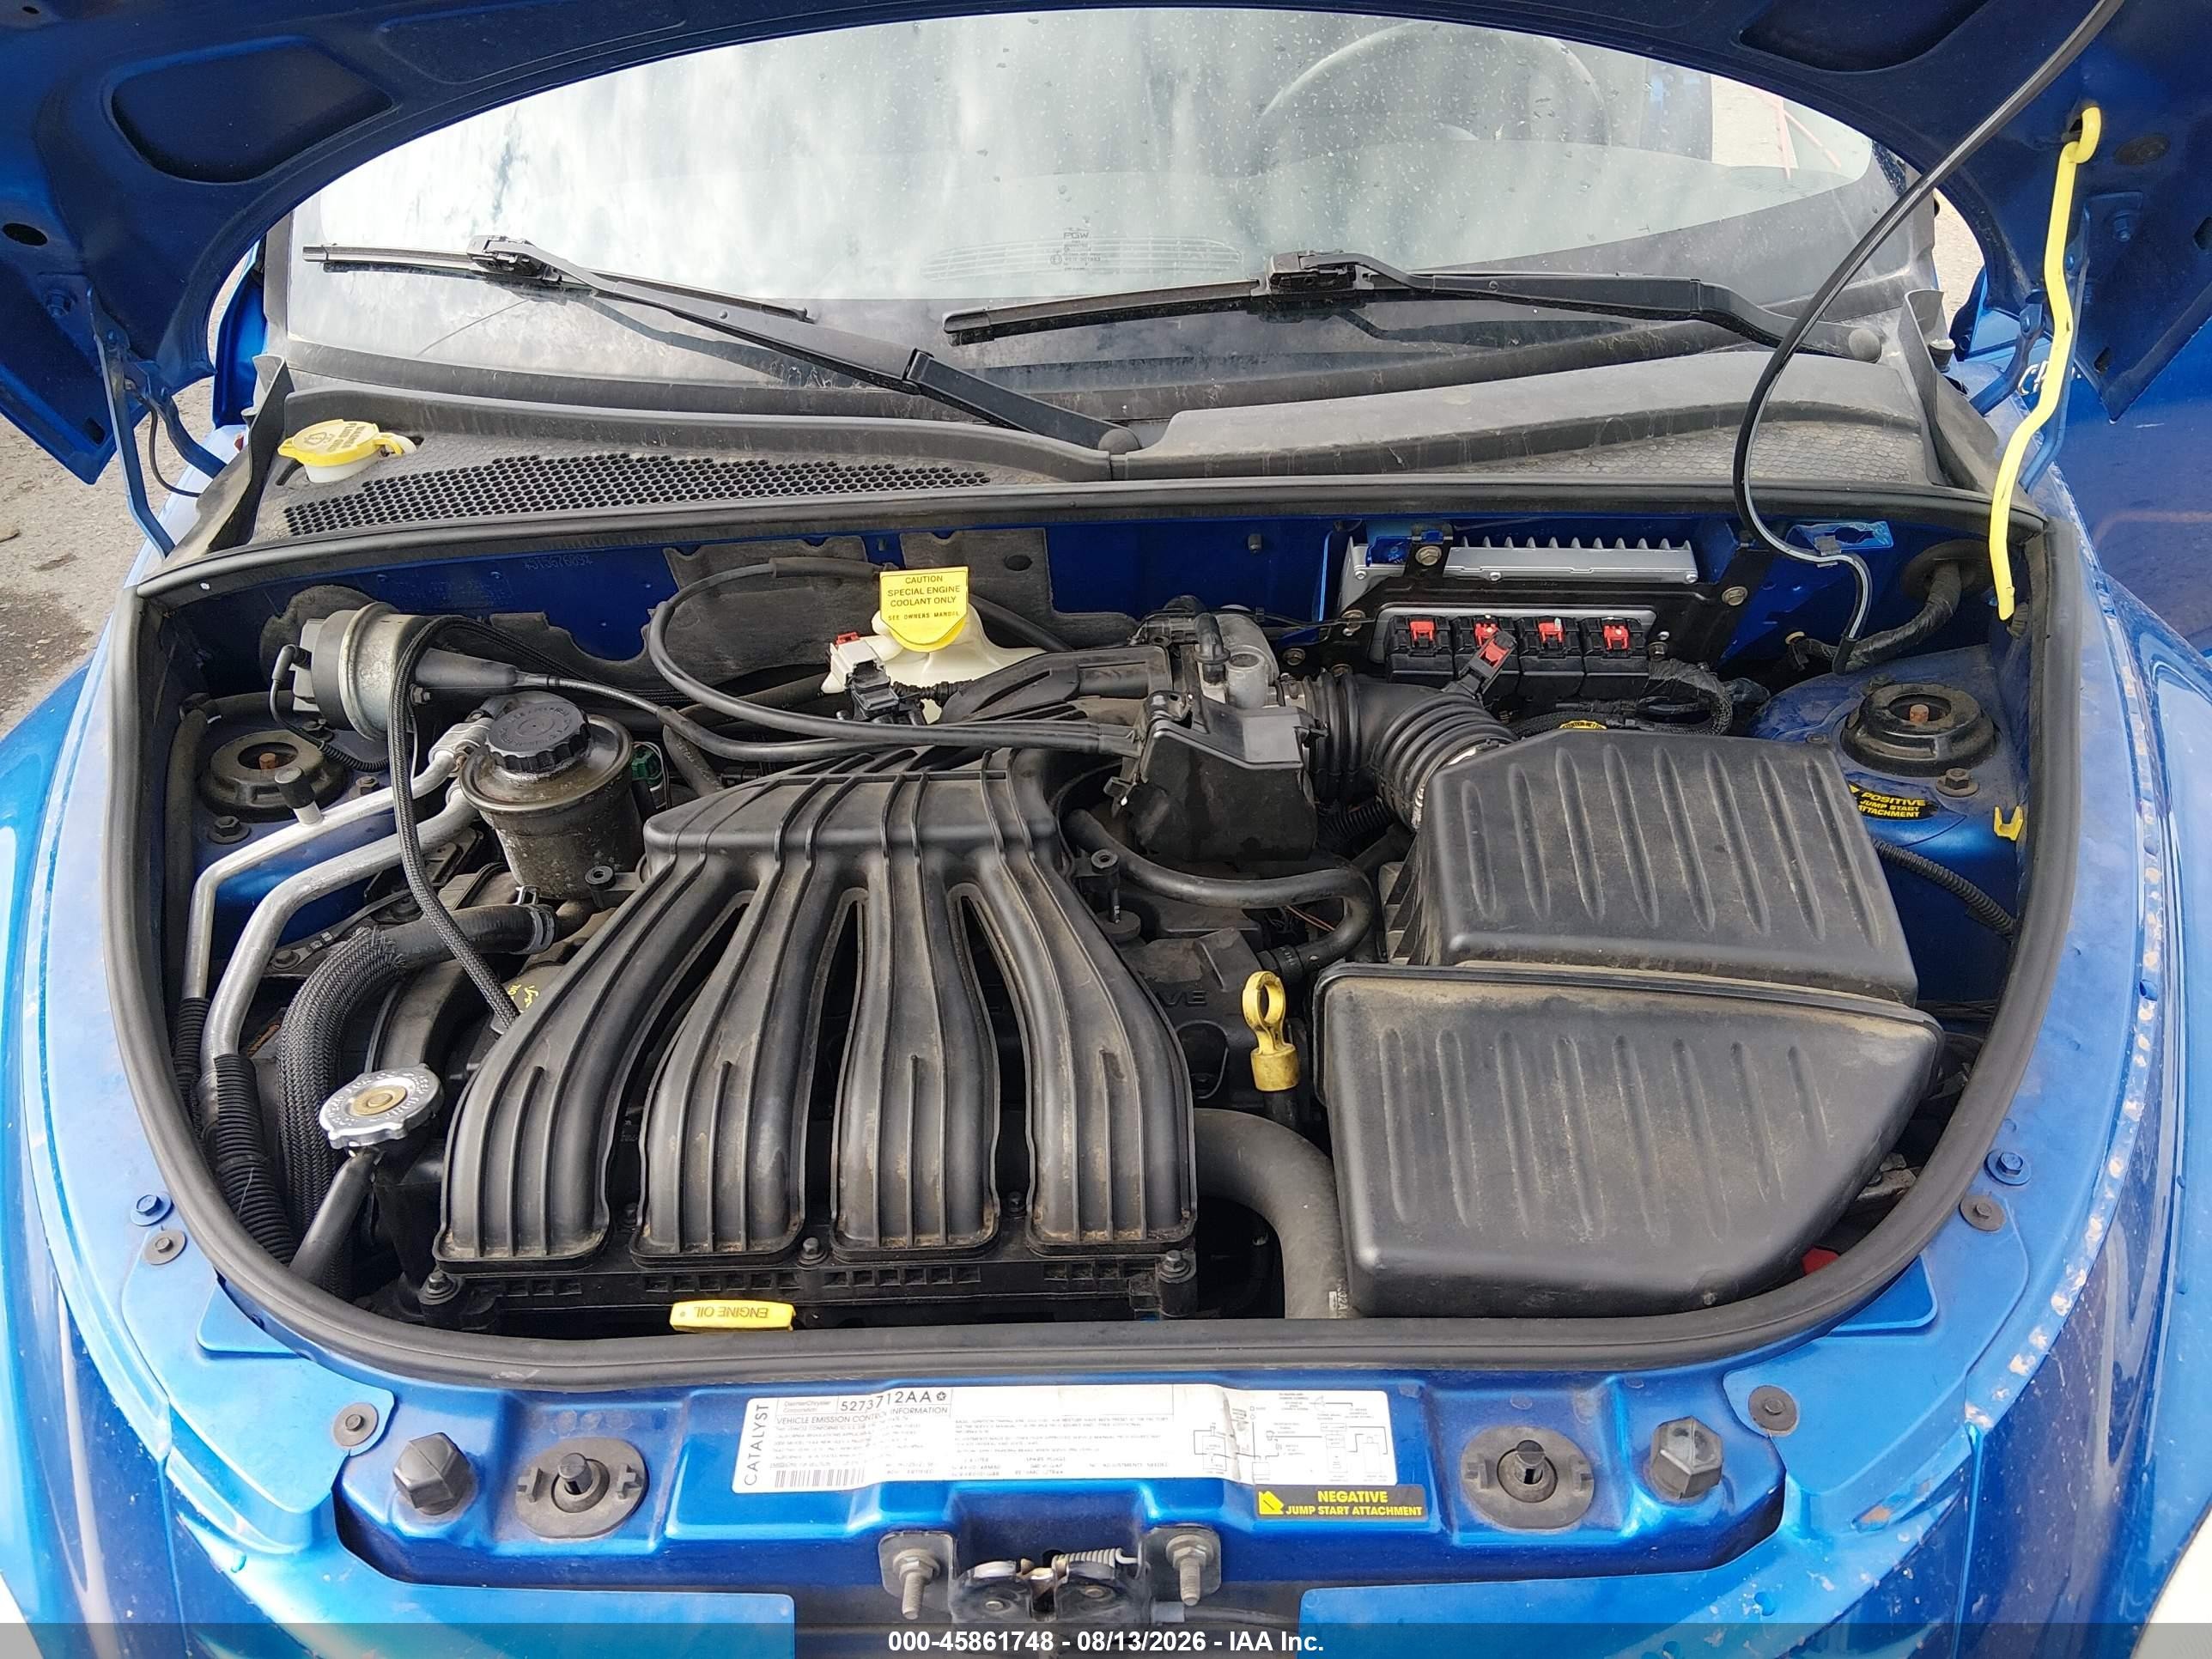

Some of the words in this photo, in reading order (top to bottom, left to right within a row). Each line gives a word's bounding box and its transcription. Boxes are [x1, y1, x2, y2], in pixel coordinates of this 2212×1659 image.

[905, 575, 943, 585] CAUTION
[888, 587, 924, 597] SPECIAL
[927, 586, 961, 594] ENGINE
[890, 598, 932, 607] COOLANT
[933, 596, 957, 605] ONLY
[1860, 799, 1887, 809] JUMP
[1861, 792, 1926, 806] POSITIVE
[1857, 805, 1920, 817] ATTACHMENT
[507, 984, 521, 995] OIL
[694, 1306, 714, 1318] OIL
[717, 1306, 769, 1319] ENGINE
[840, 1390, 932, 1412] 5273712AA
[811, 1415, 850, 1424] EMISSION
[744, 1404, 769, 1486] CATALYST
[1317, 1490, 1389, 1503] NEGATIVE
[1285, 1505, 1316, 1516] JUMP
[1317, 1505, 1350, 1515] START
[1352, 1505, 1423, 1516] ATTACHMENT
